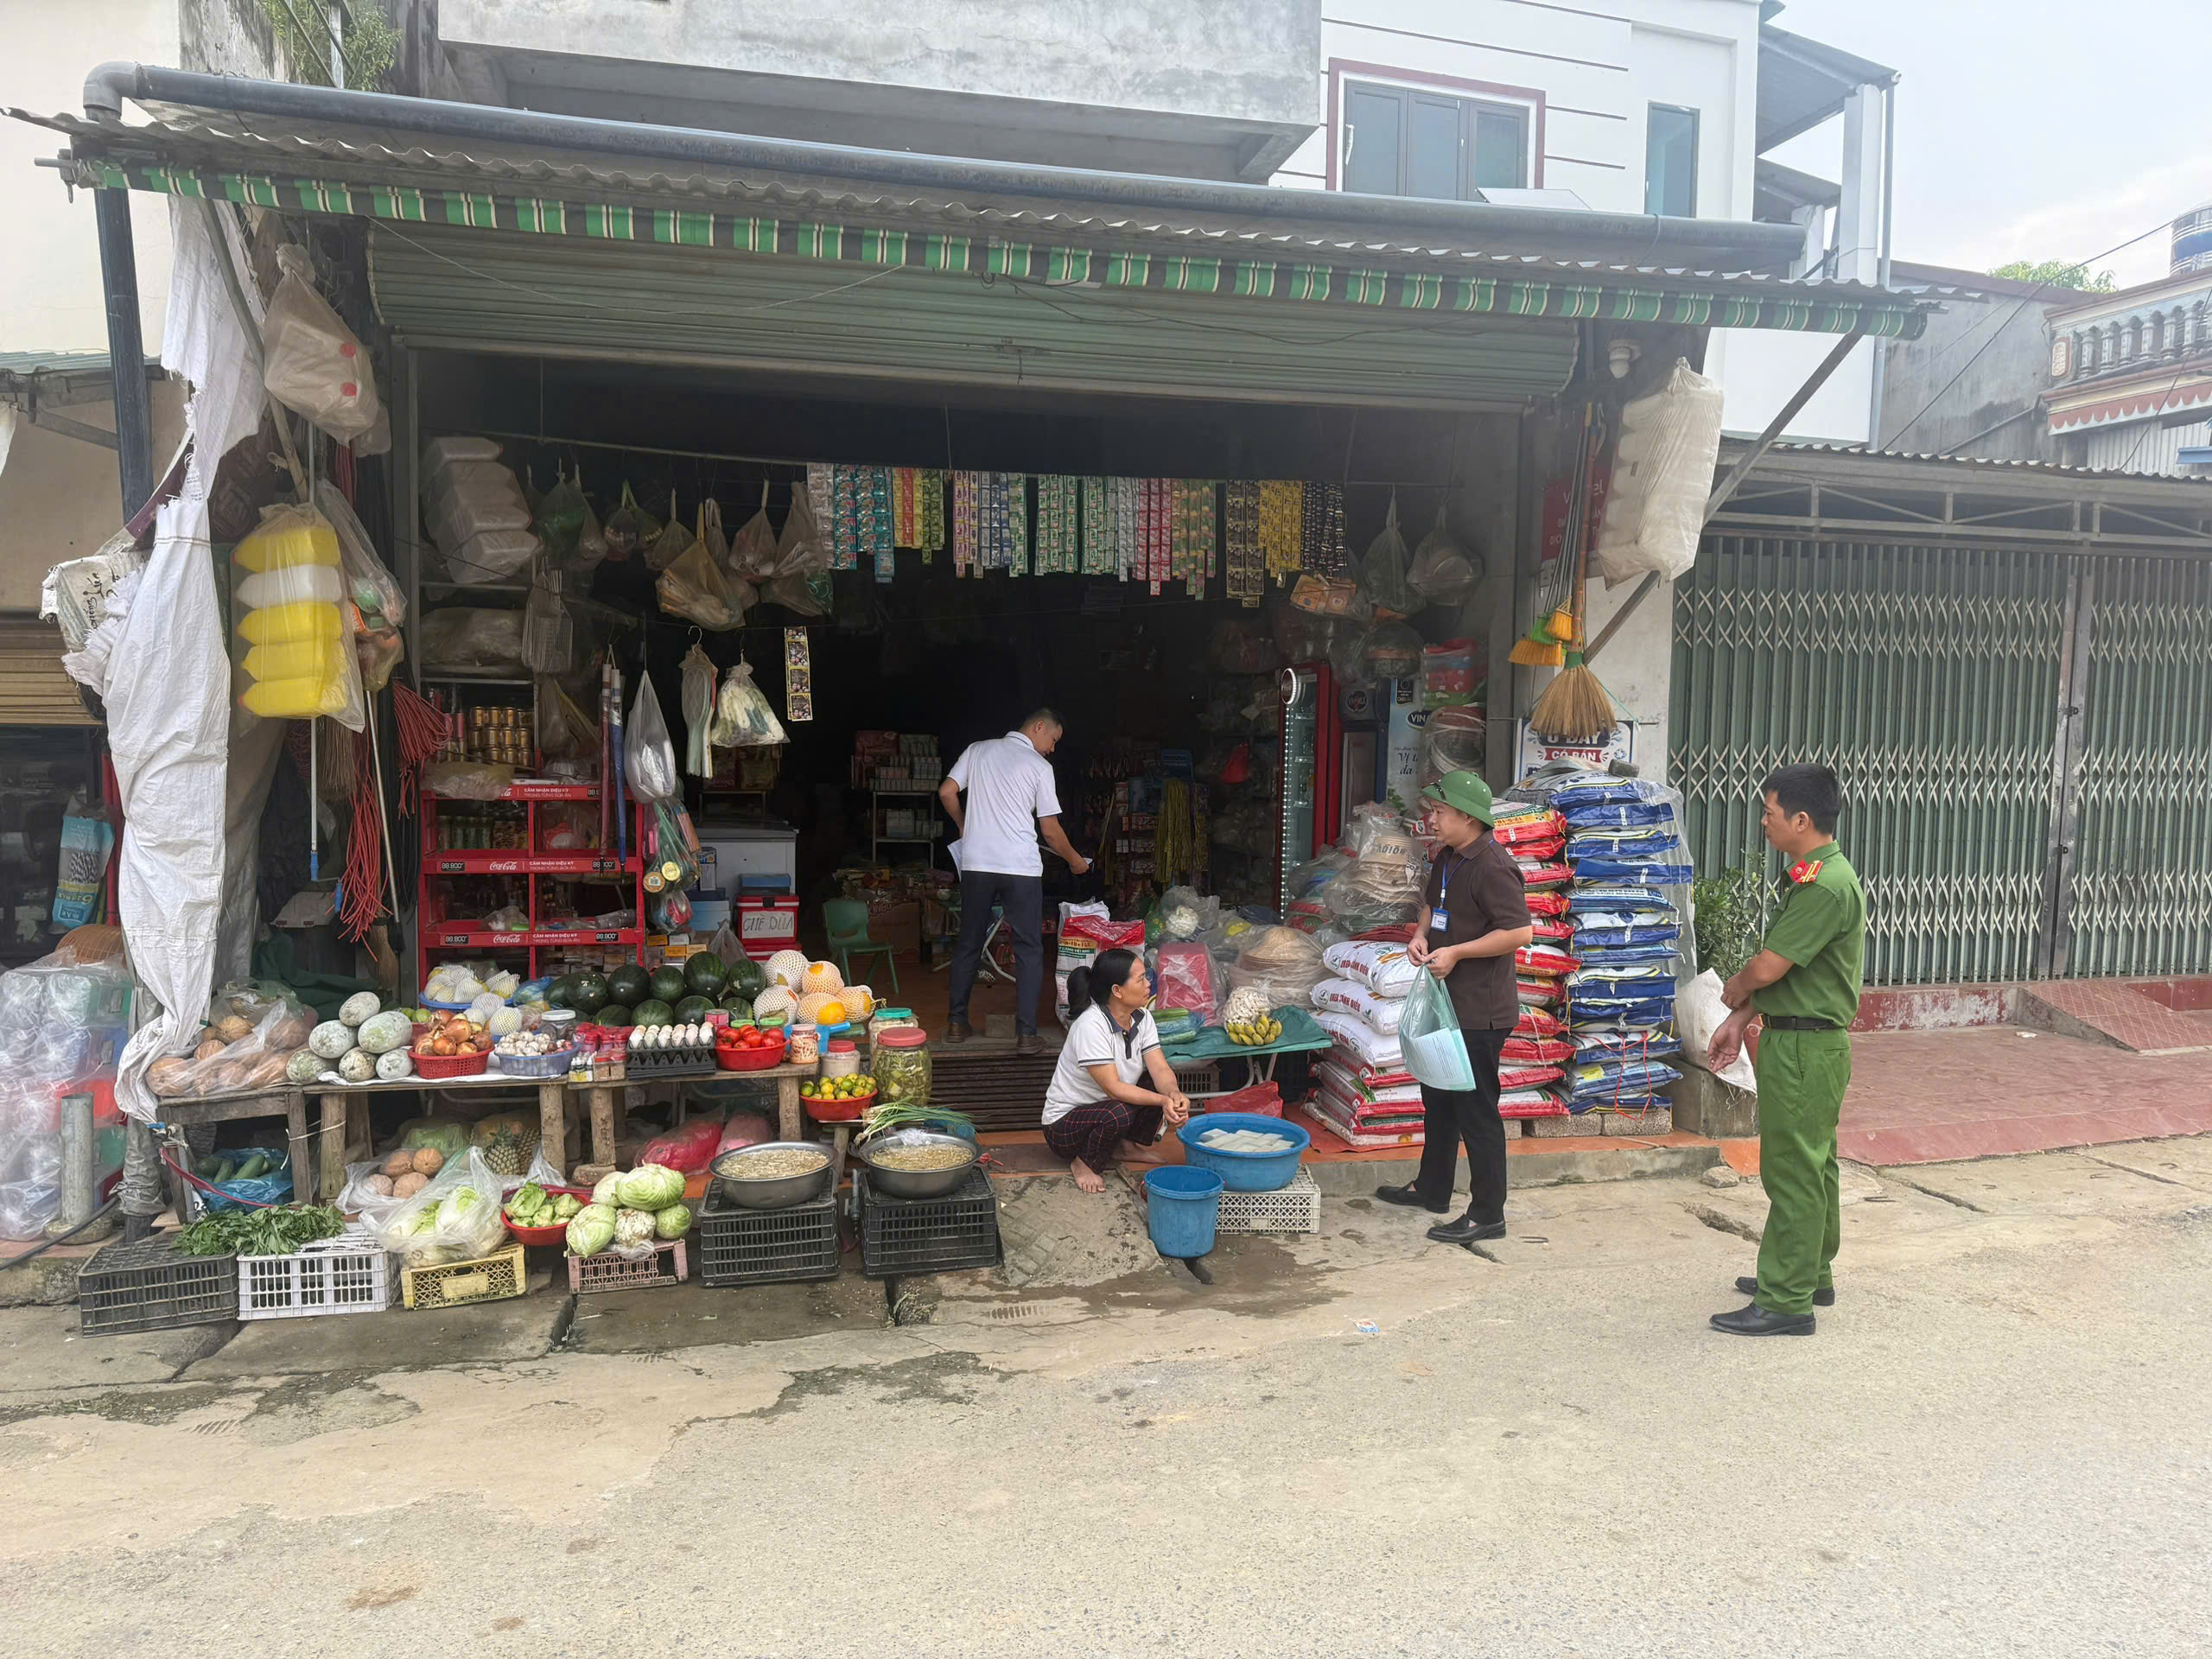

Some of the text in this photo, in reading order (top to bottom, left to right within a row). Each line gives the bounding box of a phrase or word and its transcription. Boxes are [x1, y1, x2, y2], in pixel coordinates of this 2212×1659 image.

[1411, 714, 1427, 722] VIN
[1551, 748, 1596, 760] CÓ BÁN
[1400, 765, 1413, 775] da
[490, 861, 518, 871] Coca-Cola
[743, 913, 765, 931] CHÈ
[493, 933, 521, 944] Coca-Cola
